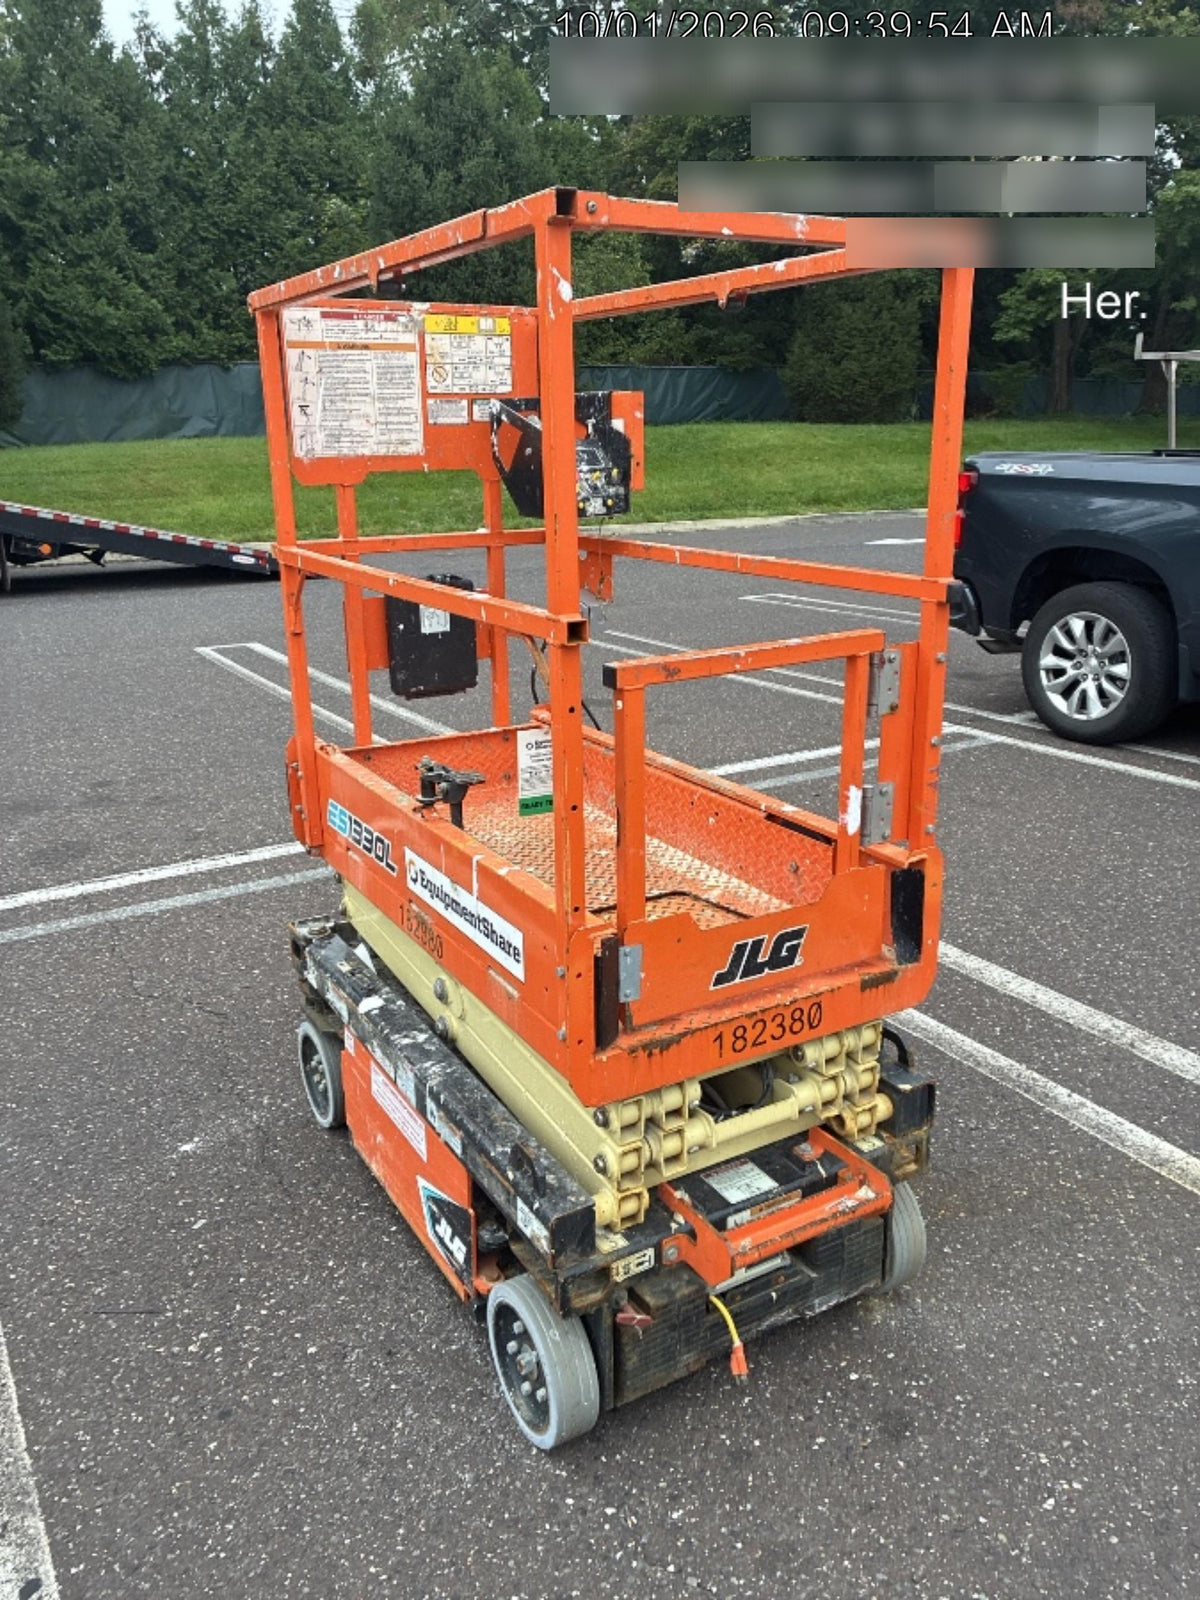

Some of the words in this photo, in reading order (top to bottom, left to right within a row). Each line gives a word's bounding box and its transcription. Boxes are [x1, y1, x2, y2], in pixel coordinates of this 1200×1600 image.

[327, 799, 398, 876] ES1330L
[418, 867, 523, 964] EquipmentShare
[708, 924, 809, 991] JLG
[712, 1000, 823, 1059] 182380
[434, 1216, 468, 1266] JLG
